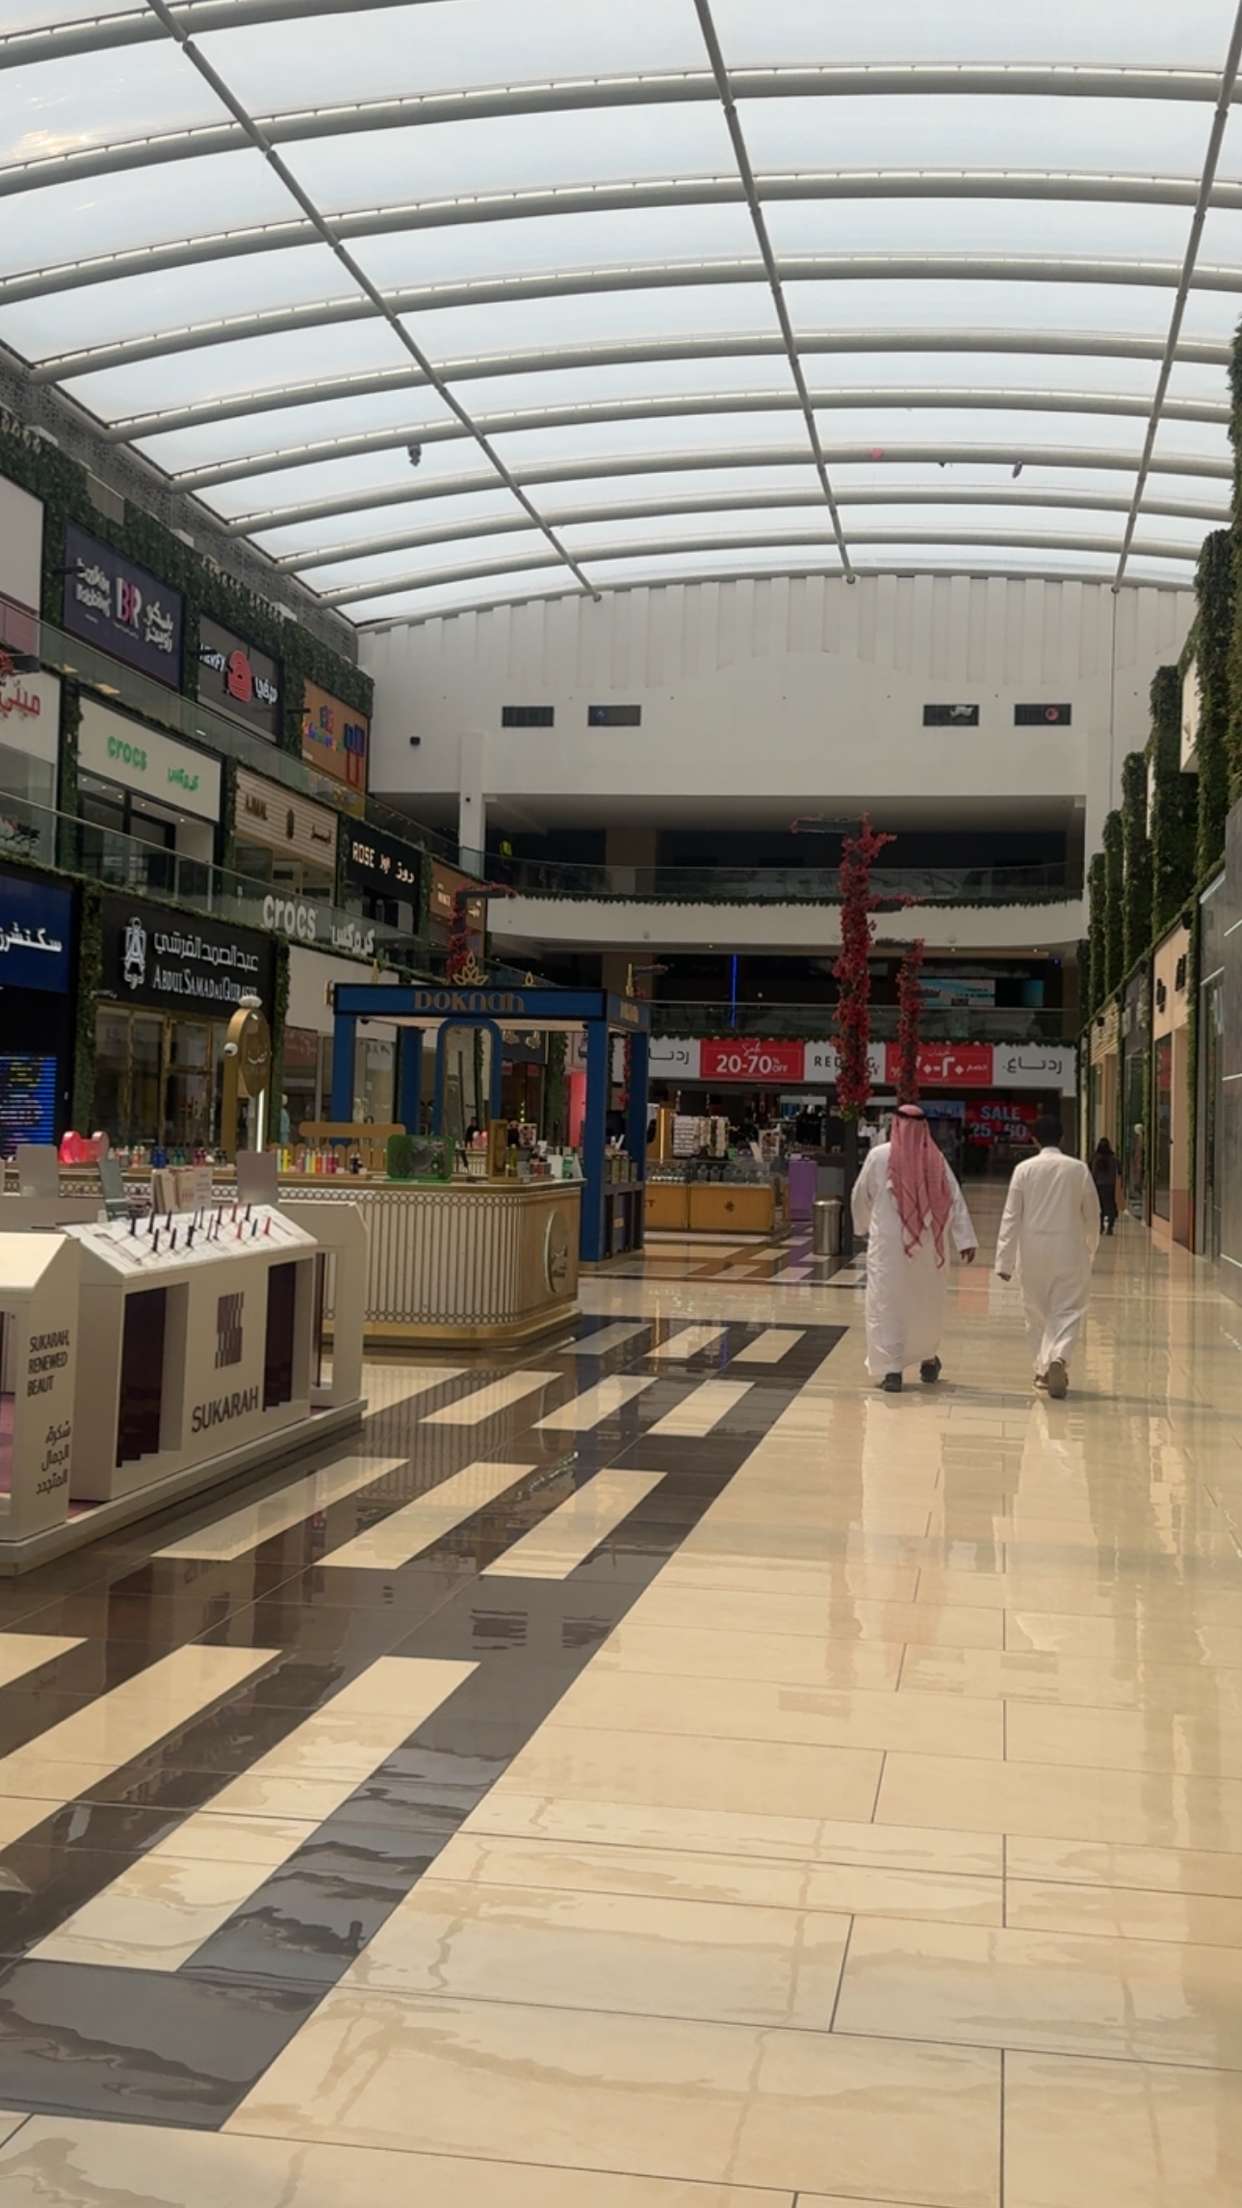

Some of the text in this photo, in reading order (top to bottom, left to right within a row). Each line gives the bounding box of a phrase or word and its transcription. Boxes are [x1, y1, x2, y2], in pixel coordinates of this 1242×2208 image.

[116, 577, 142, 628] BR
[352, 841, 376, 869] ROSE
[262, 895, 317, 940] crocs
[331, 922, 376, 957] كروكس
[716, 1054, 772, 1074] 20-70
[979, 1104, 1021, 1121] SALE
[192, 1385, 259, 1433] SUKARAH
